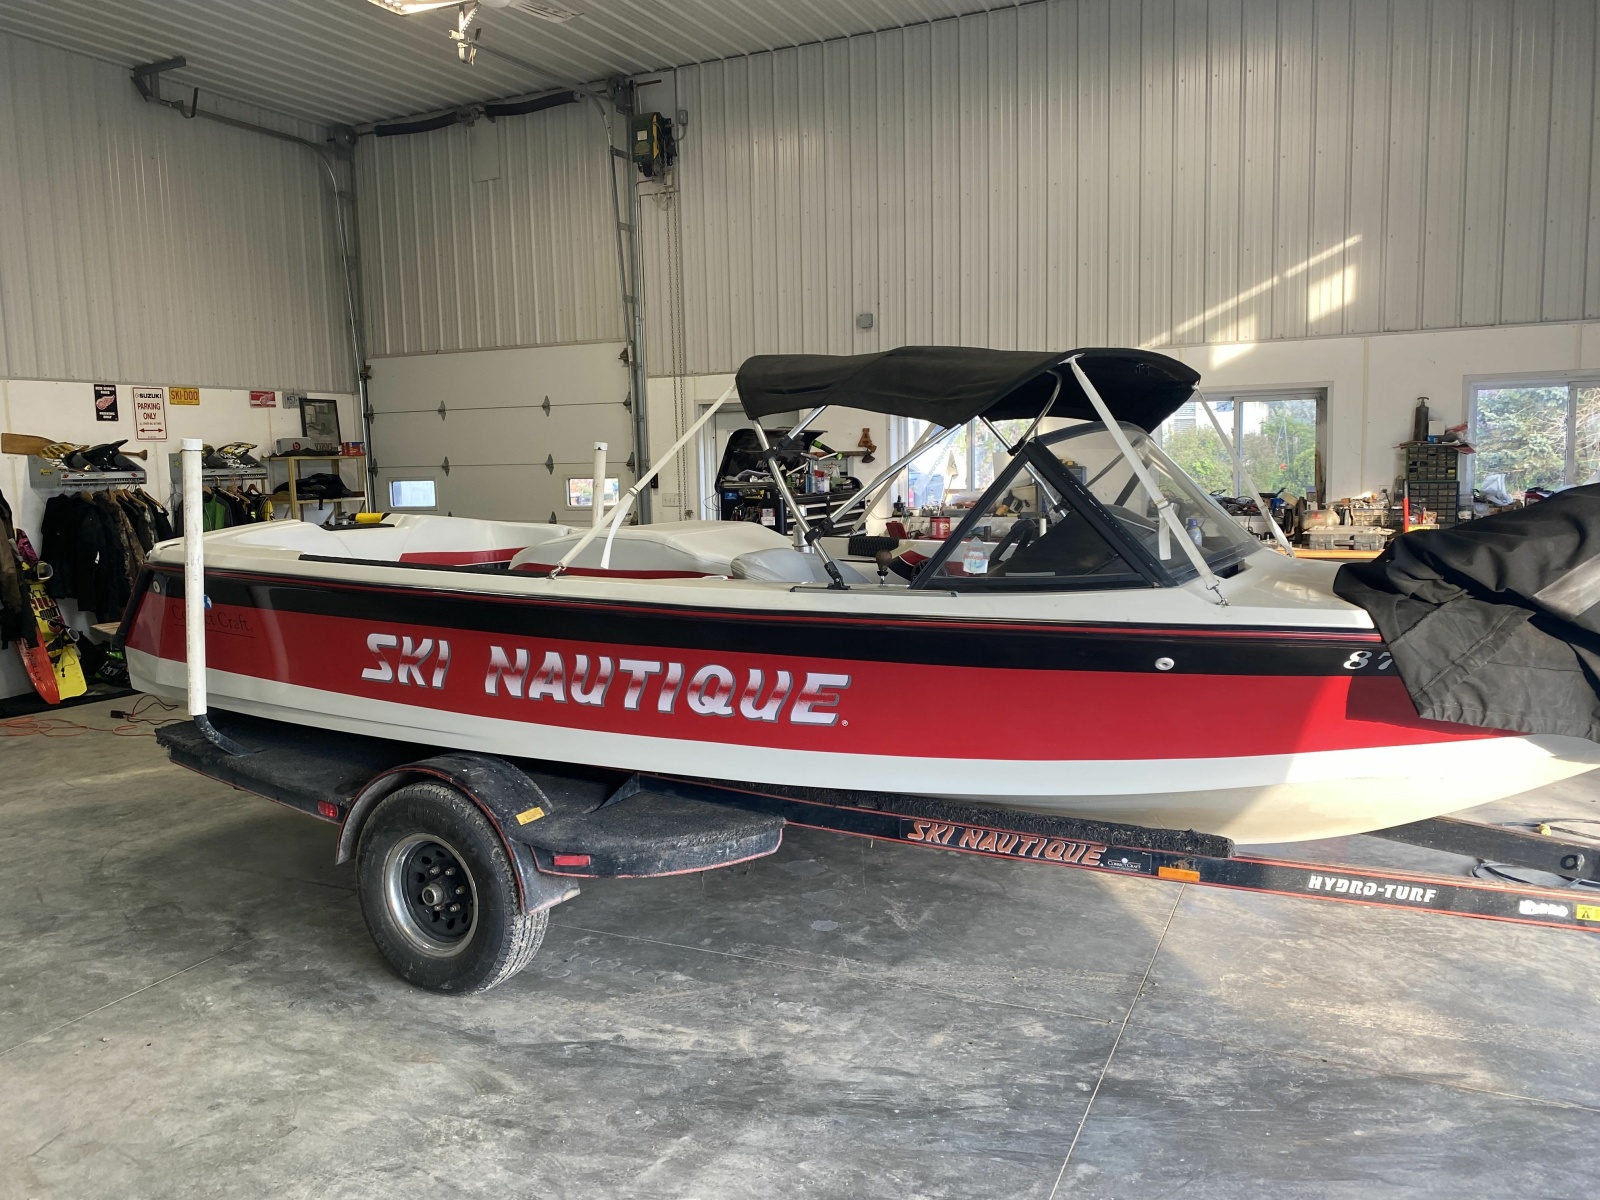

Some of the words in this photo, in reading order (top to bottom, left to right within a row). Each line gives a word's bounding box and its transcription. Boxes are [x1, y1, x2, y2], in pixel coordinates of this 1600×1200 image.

[137, 402, 161, 410] PARKING
[170, 390, 199, 401] SKI-DOO
[143, 412, 157, 420] ONLY
[217, 611, 251, 632] Craft
[361, 632, 451, 689] SKI
[484, 645, 851, 726] NAUTIQUE
[907, 821, 955, 845] SKI
[958, 827, 1107, 866] NAUTIQUE
[1308, 874, 1437, 903] HYDRO-TURF
